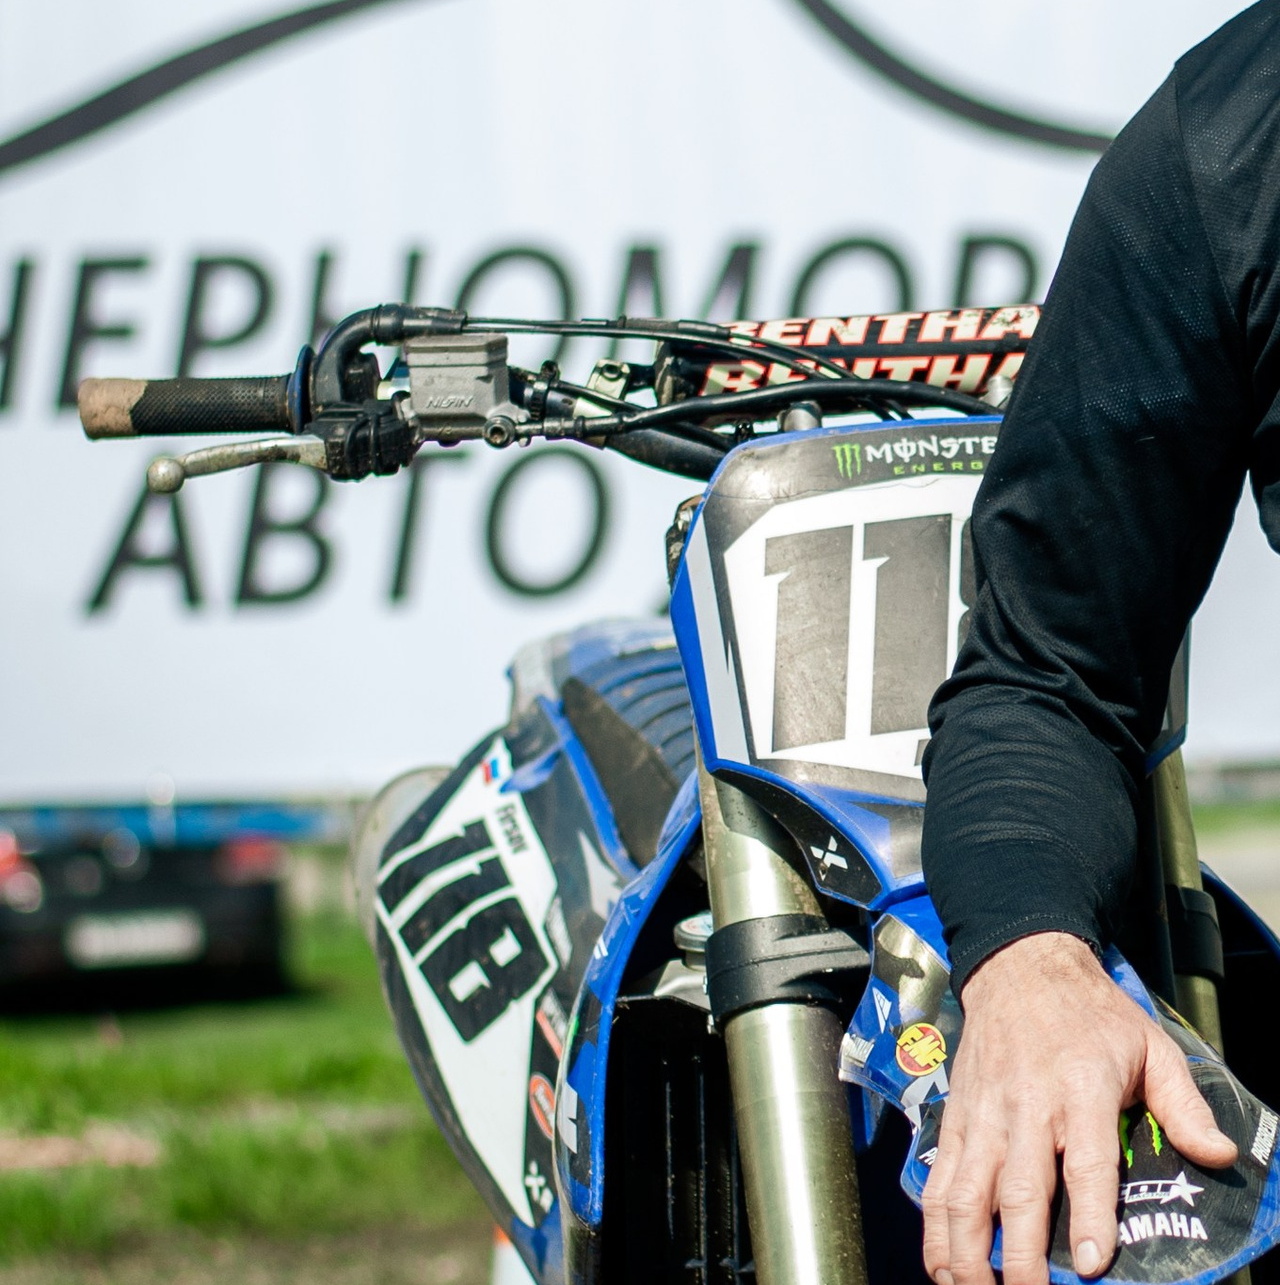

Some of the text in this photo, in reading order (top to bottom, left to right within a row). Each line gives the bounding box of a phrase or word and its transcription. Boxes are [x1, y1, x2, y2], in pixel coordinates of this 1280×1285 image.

[0, 233, 1040, 411] ЕРНОМОР
[712, 305, 1040, 347] RENTHA
[865, 435, 999, 464] MONSTE
[893, 460, 984, 475] ENERG
[82, 443, 620, 613] АВТО
[764, 513, 975, 752] 11
[379, 818, 551, 1046] 118
[896, 1026, 948, 1068] FMF
[1117, 1212, 1208, 1247] AMAHA
